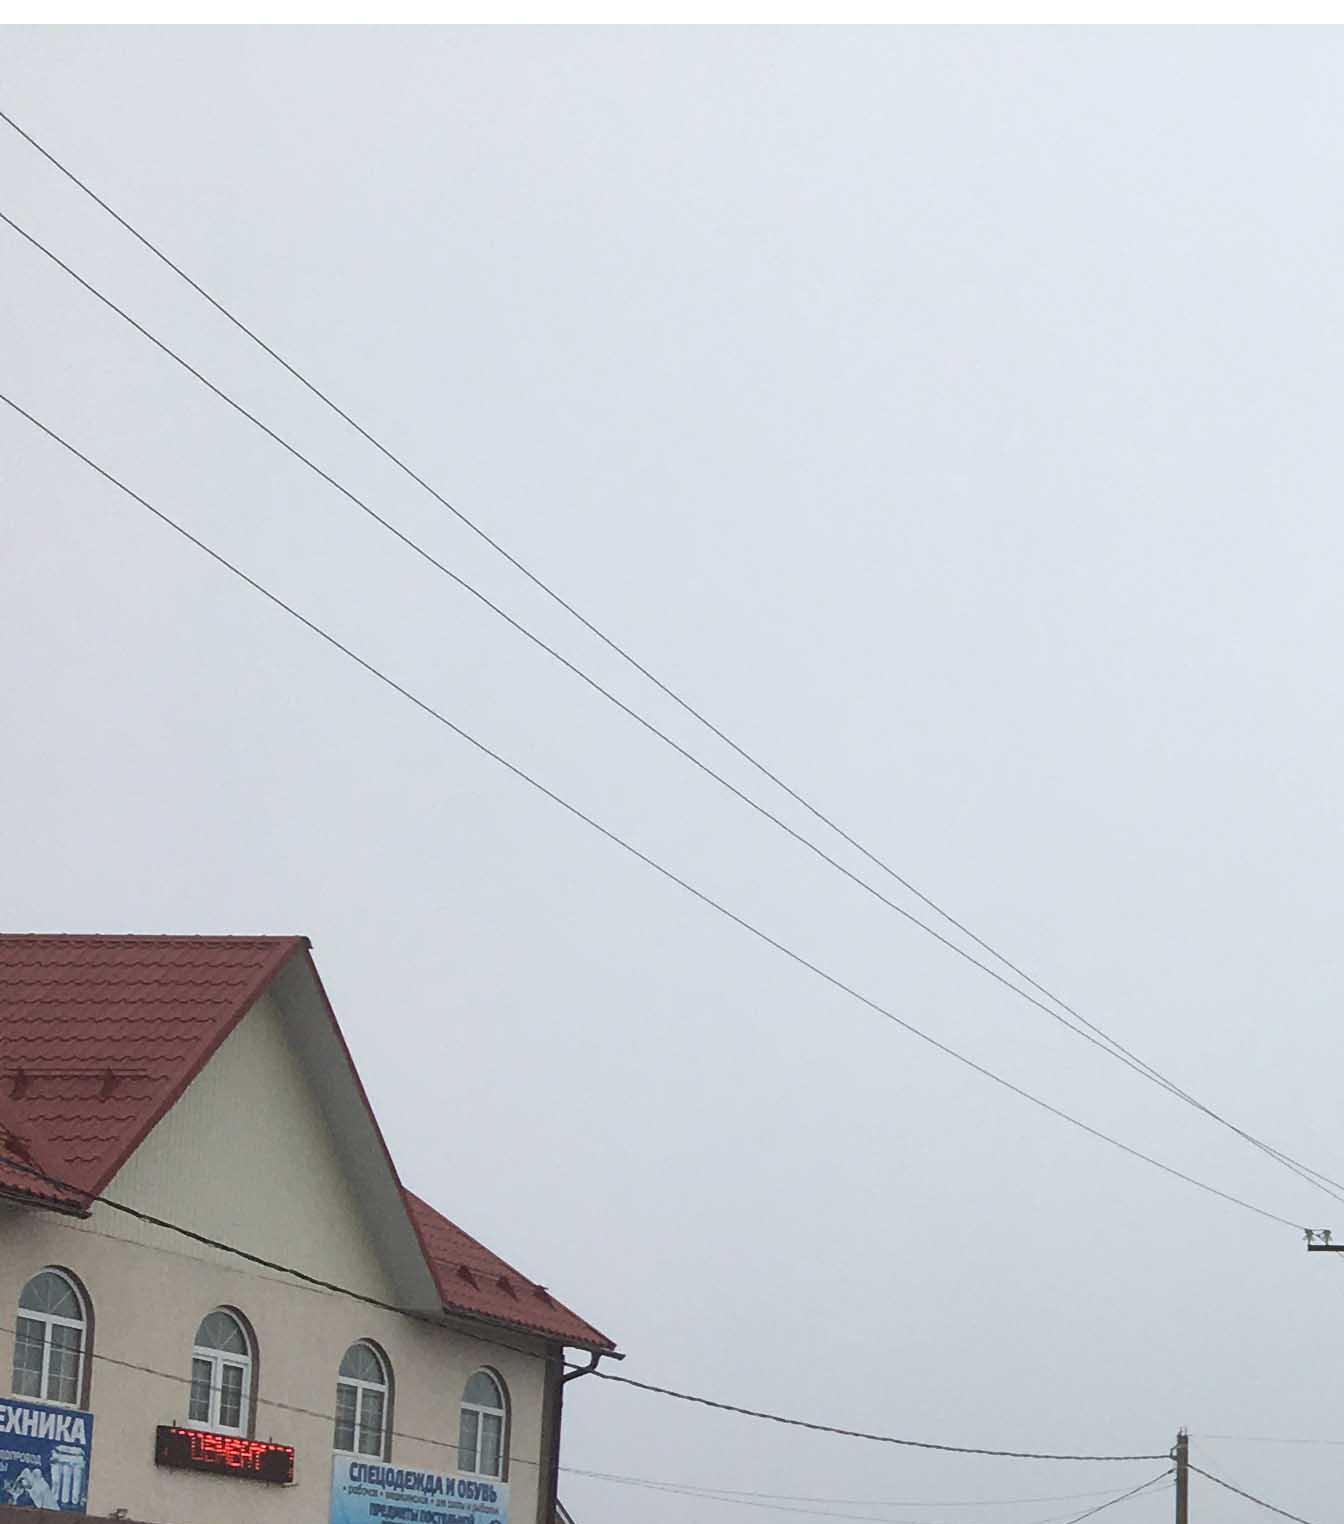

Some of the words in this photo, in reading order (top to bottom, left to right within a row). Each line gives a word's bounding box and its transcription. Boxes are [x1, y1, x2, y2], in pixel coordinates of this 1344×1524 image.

[350, 1462, 443, 1498] СПЕЦОДЕЖДА
[446, 1478, 455, 1497] И
[457, 1480, 498, 1504] ОБУВЬ
